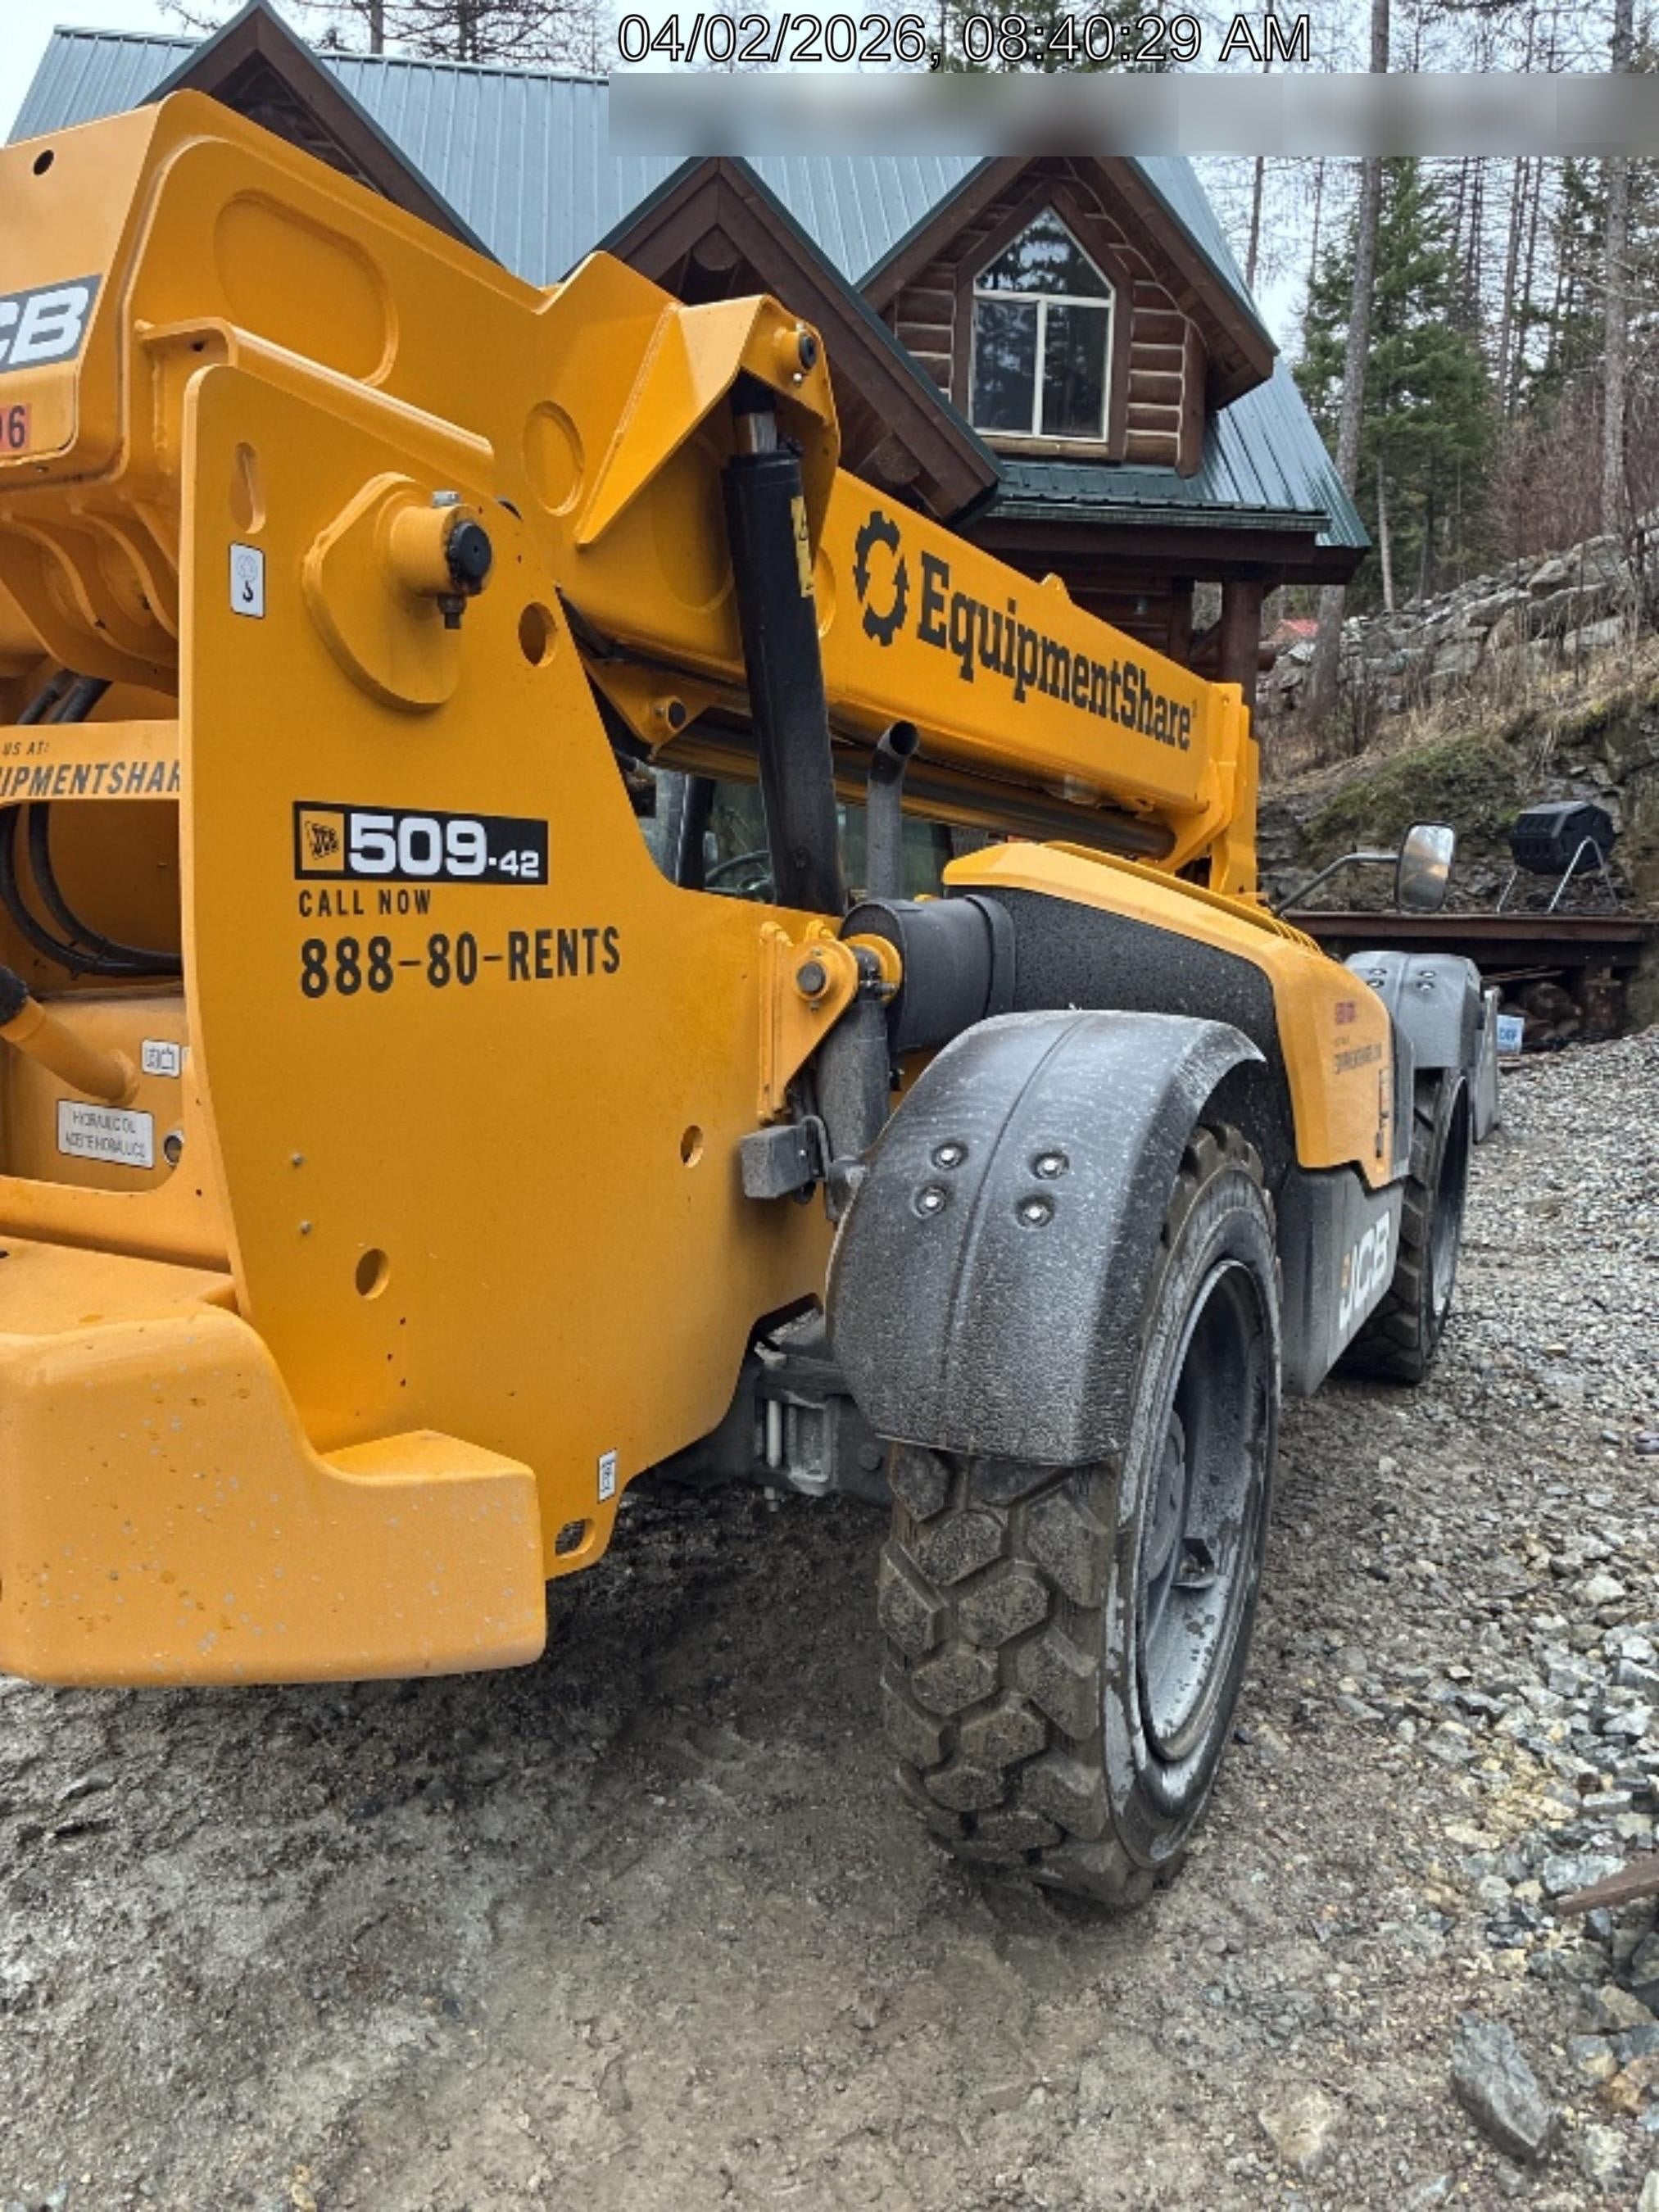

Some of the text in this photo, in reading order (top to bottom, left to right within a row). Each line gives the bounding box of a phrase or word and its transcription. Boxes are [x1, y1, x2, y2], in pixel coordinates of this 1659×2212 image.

[916, 550, 1192, 751] EquipmentShare
[299, 889, 432, 918] CALL NOW
[301, 926, 621, 999] 888-80-RENTS
[1339, 1211, 1390, 1331] JCB
